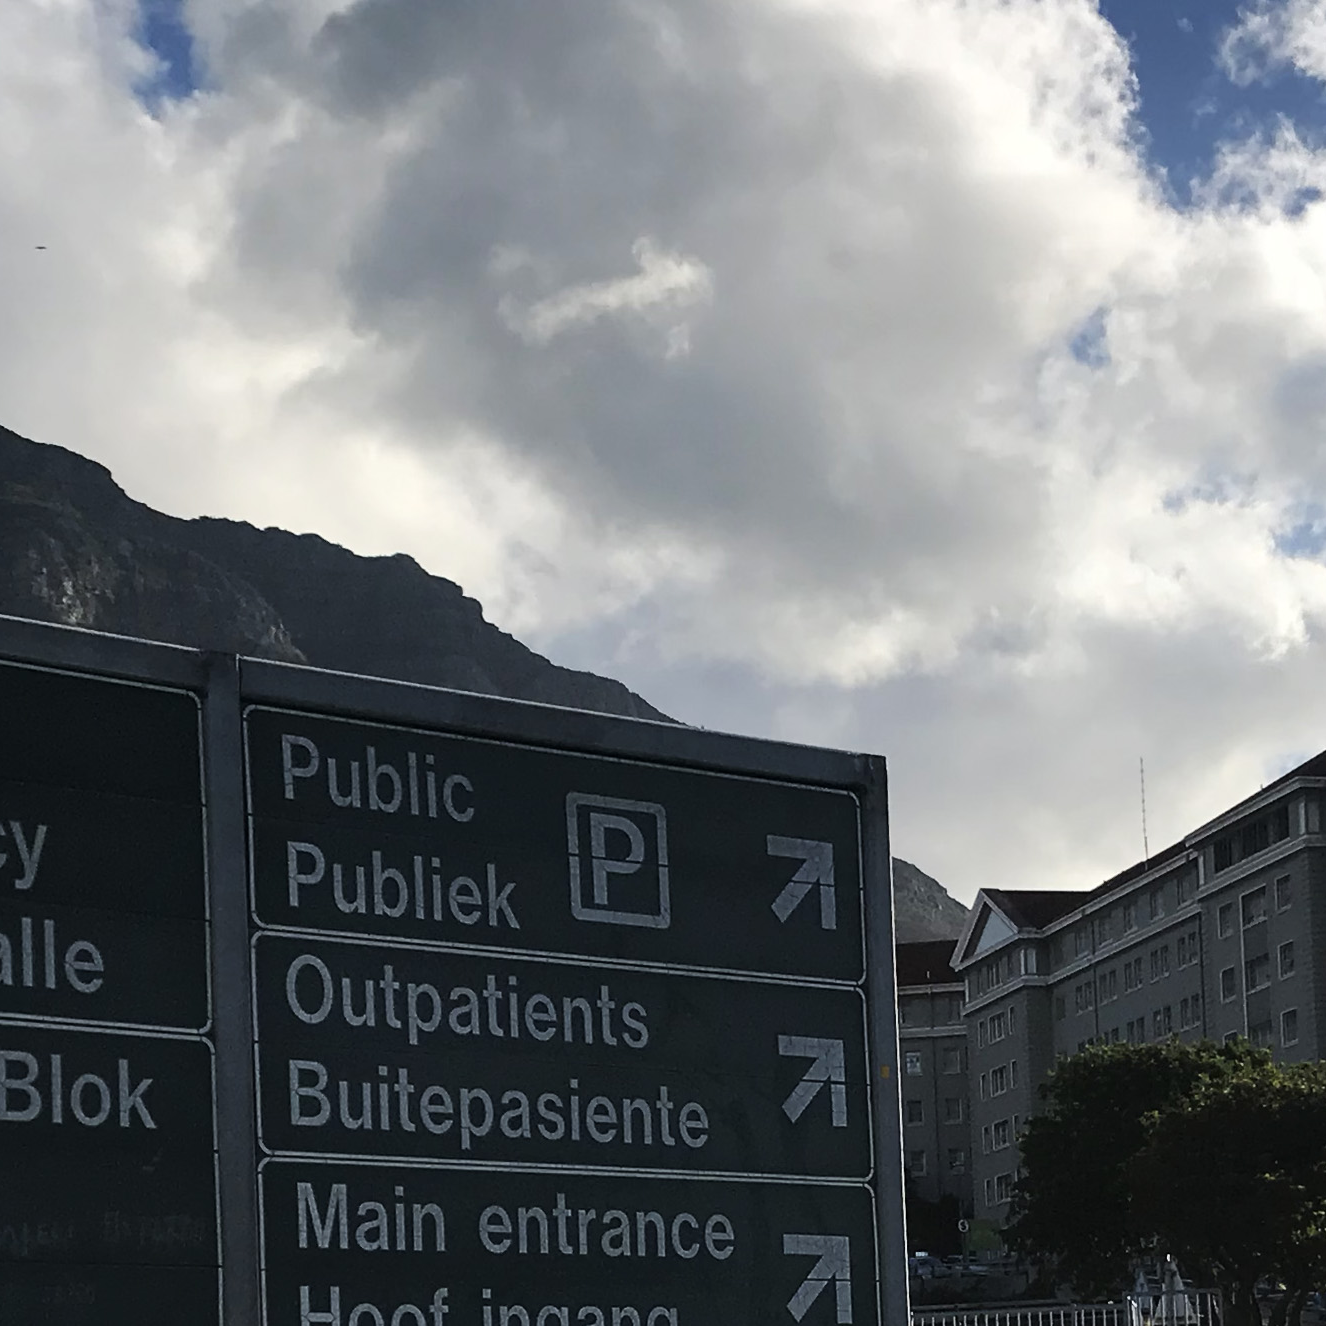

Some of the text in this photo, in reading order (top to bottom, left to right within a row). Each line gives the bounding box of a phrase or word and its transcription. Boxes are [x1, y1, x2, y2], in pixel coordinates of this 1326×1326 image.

[281, 734, 475, 823] Public
[287, 841, 520, 929] Publiek
[590, 812, 645, 904] P
[286, 955, 649, 1048] Outpatients
[289, 1060, 709, 1149] Buitepasiente
[297, 1182, 735, 1260] Main entrance
